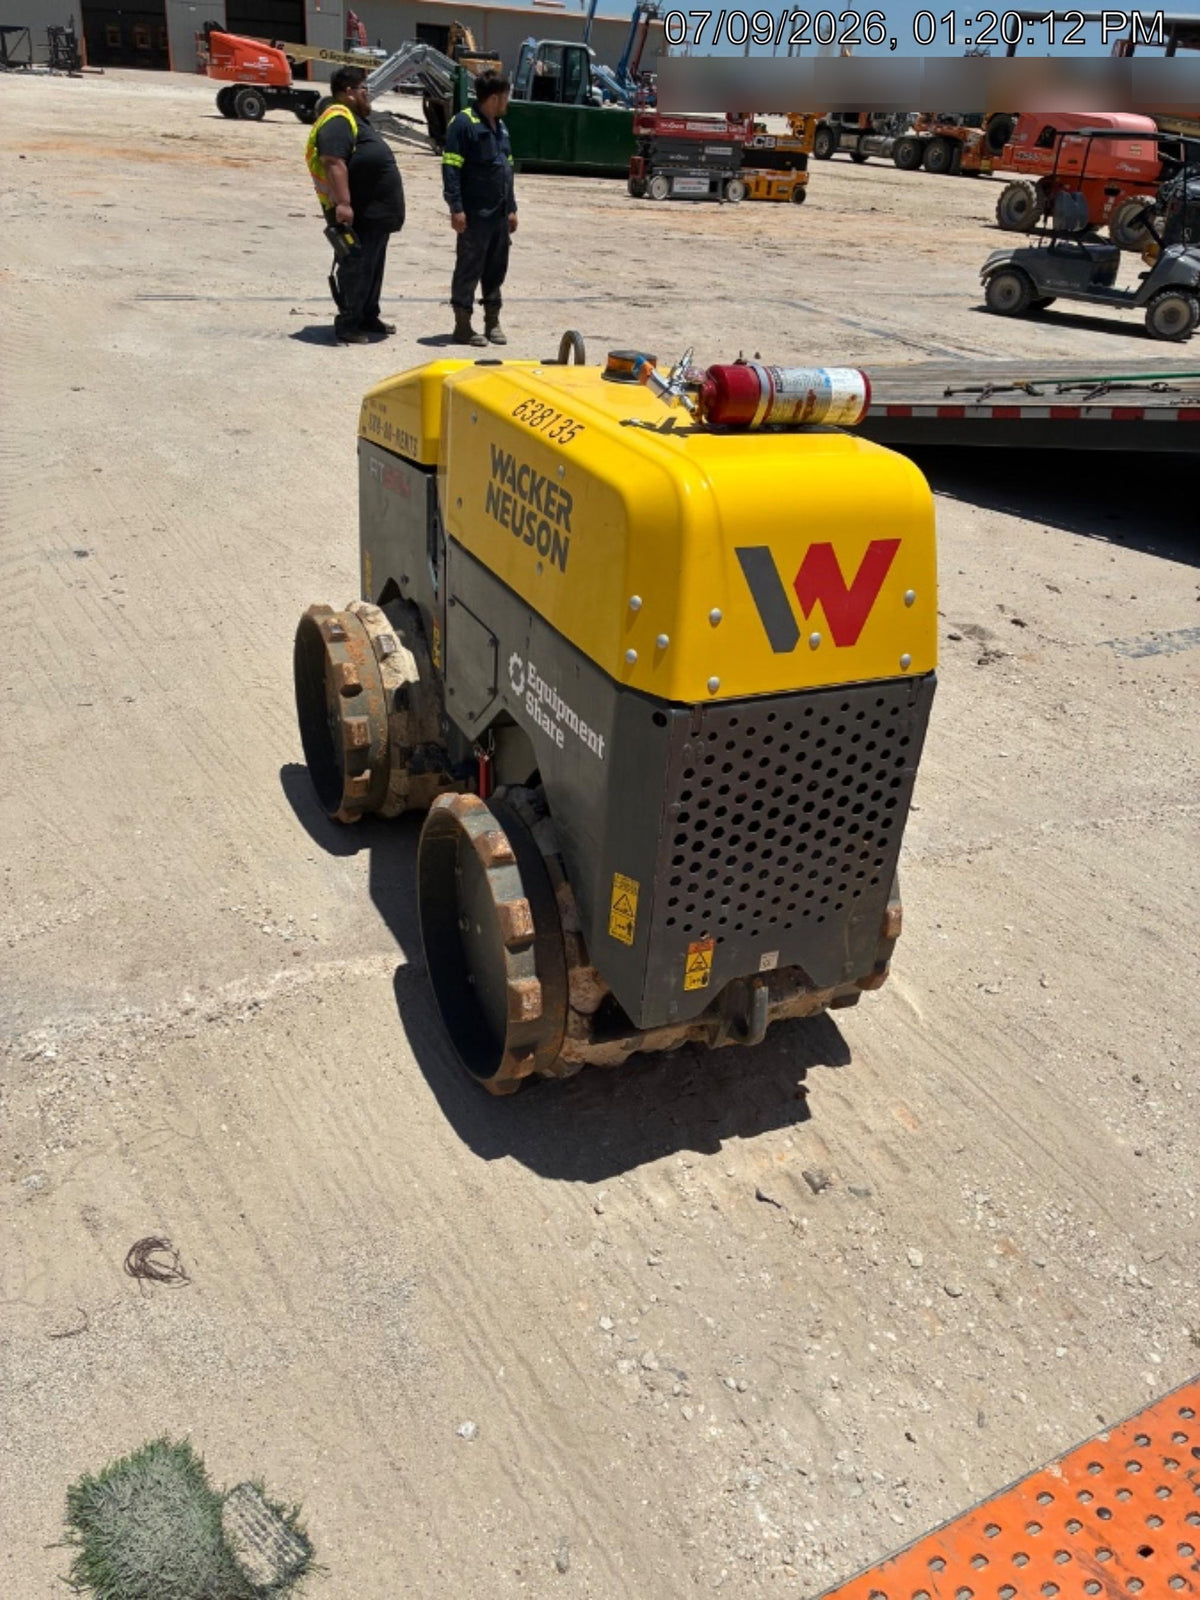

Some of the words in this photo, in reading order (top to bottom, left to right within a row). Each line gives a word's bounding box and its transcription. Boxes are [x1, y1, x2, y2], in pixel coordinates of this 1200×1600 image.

[512, 398, 585, 445] 638135
[485, 480, 570, 574] NEUSON
[490, 442, 573, 533] WACKER
[525, 690, 564, 749] Share
[527, 661, 605, 760] Equipment
